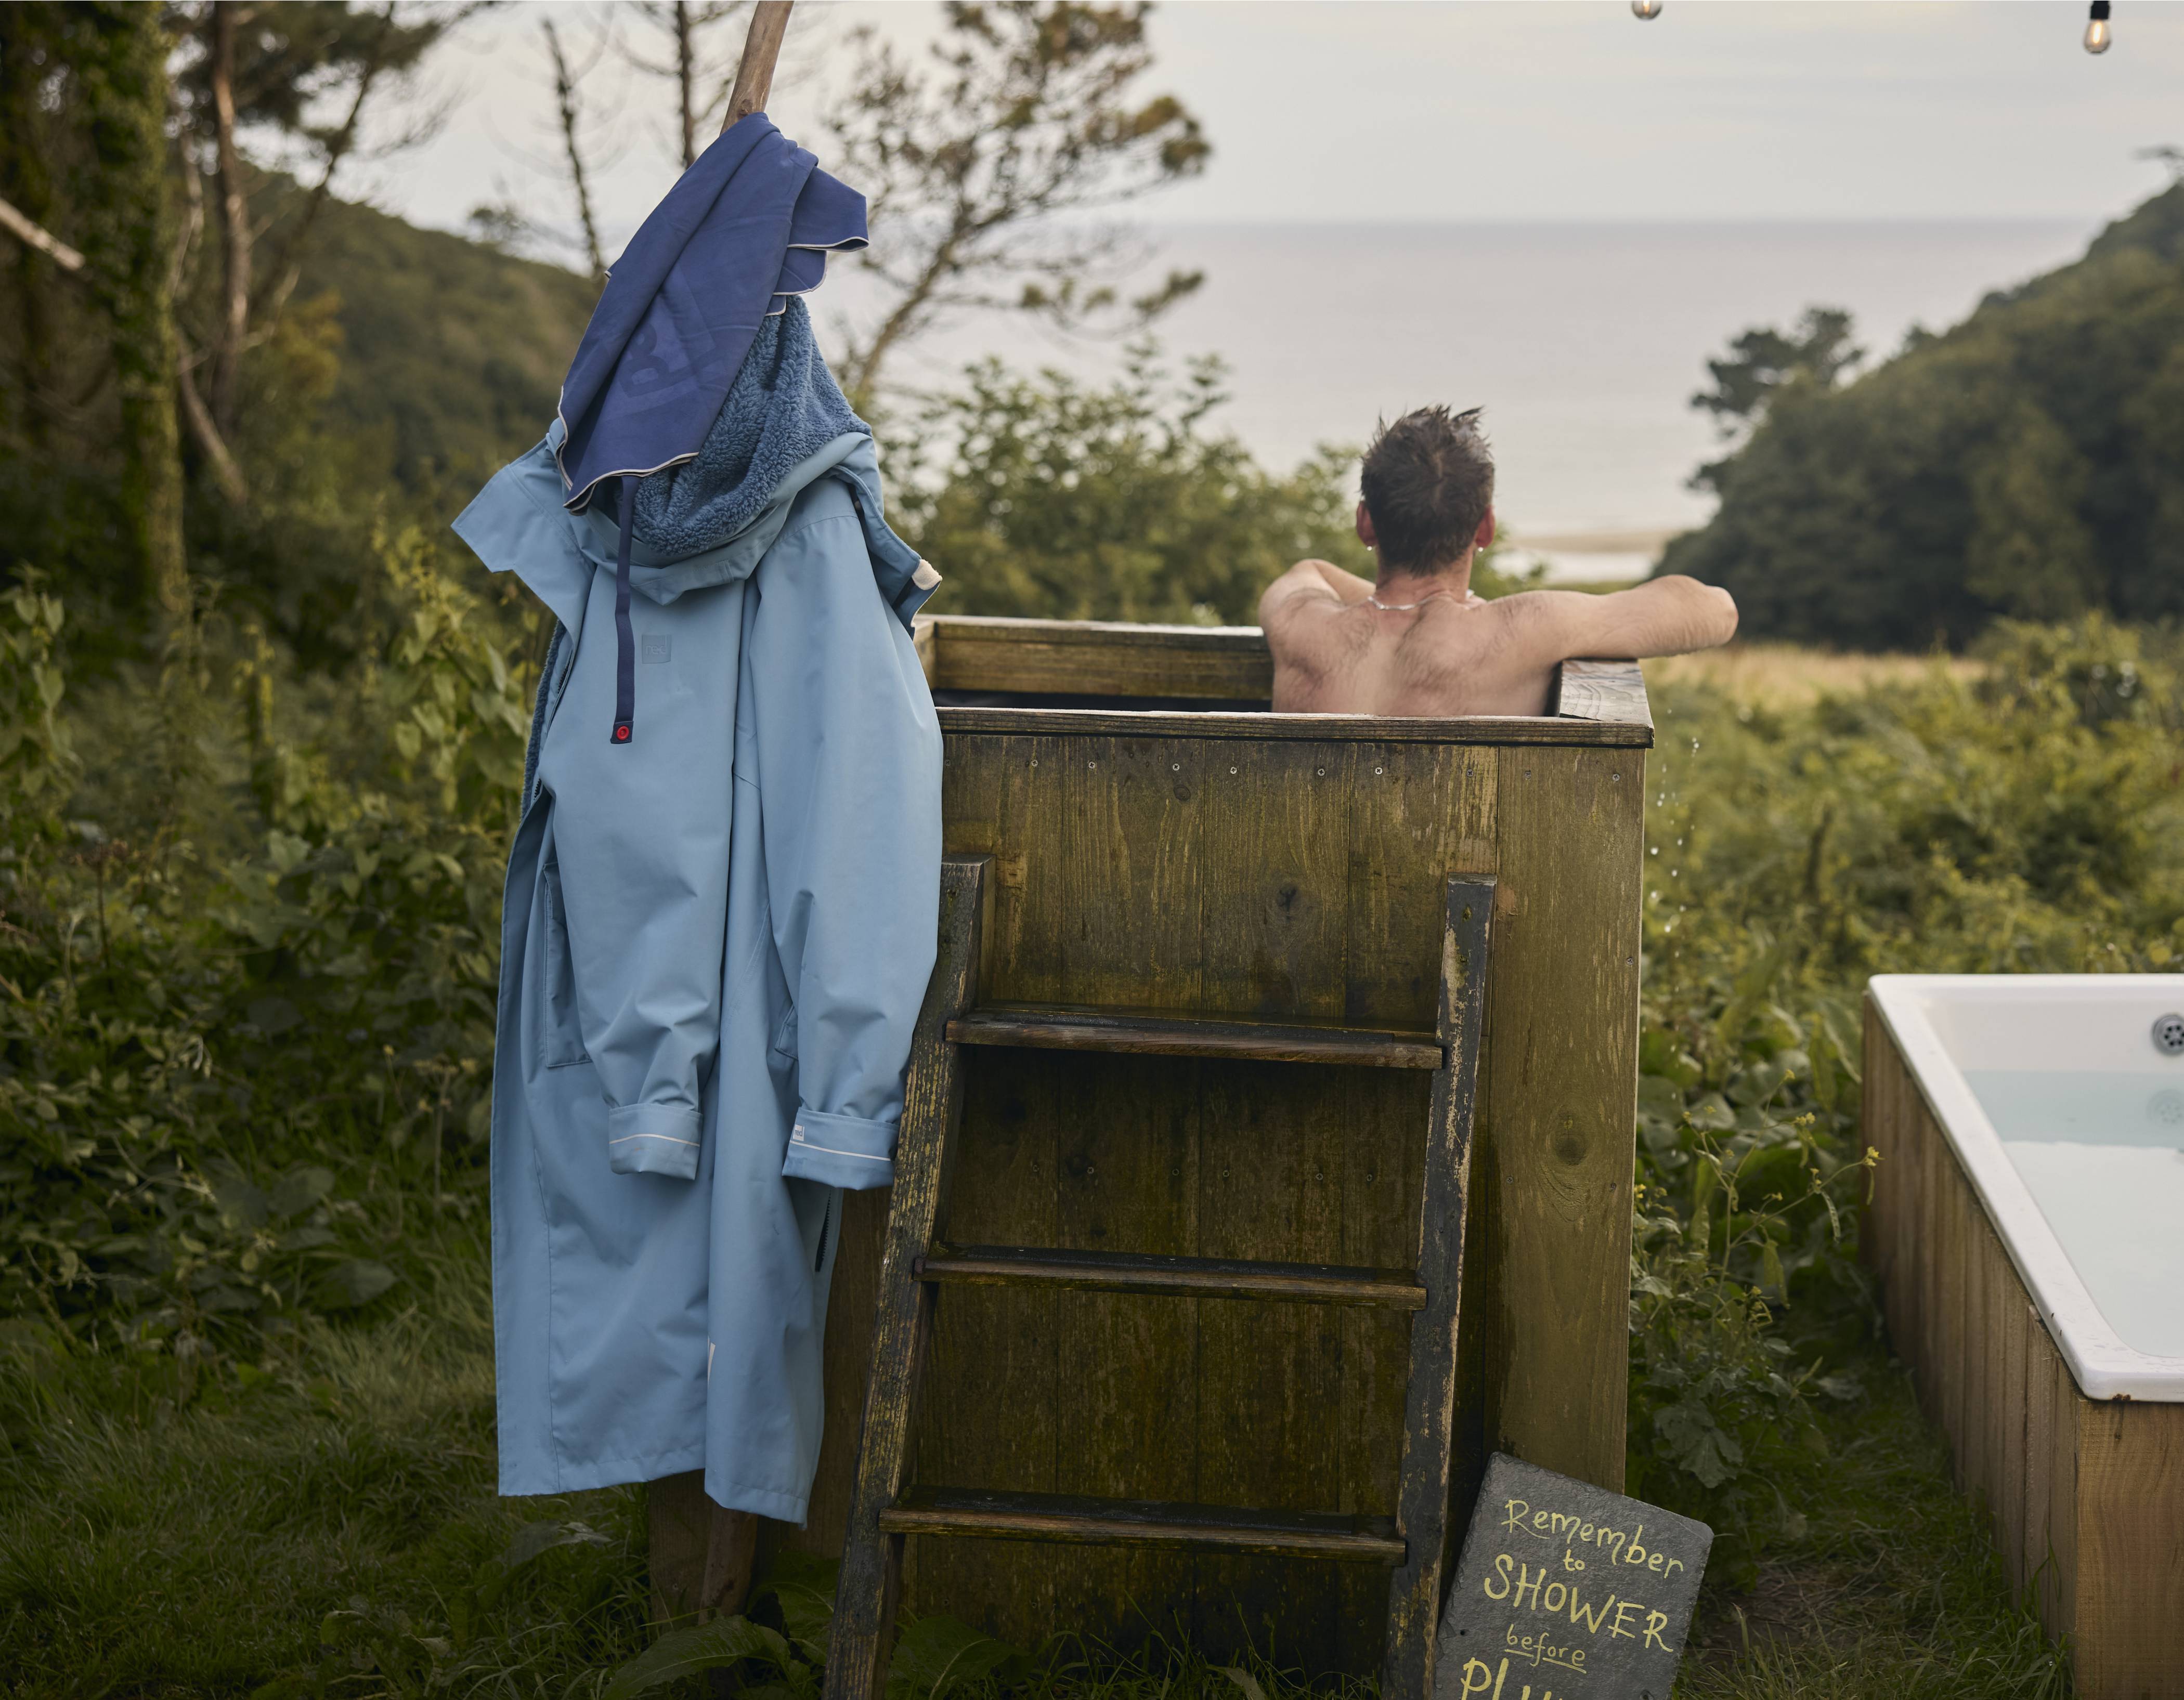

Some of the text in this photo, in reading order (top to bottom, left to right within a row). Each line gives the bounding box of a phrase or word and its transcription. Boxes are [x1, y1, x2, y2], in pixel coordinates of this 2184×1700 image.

[645, 635, 667, 654] red
[794, 1126, 803, 1136] red
[1501, 1499, 1684, 1578] Remember
[1563, 1549, 1585, 1572] to
[1484, 1554, 1673, 1652] SHOWER
[1506, 1624, 1586, 1667] before
